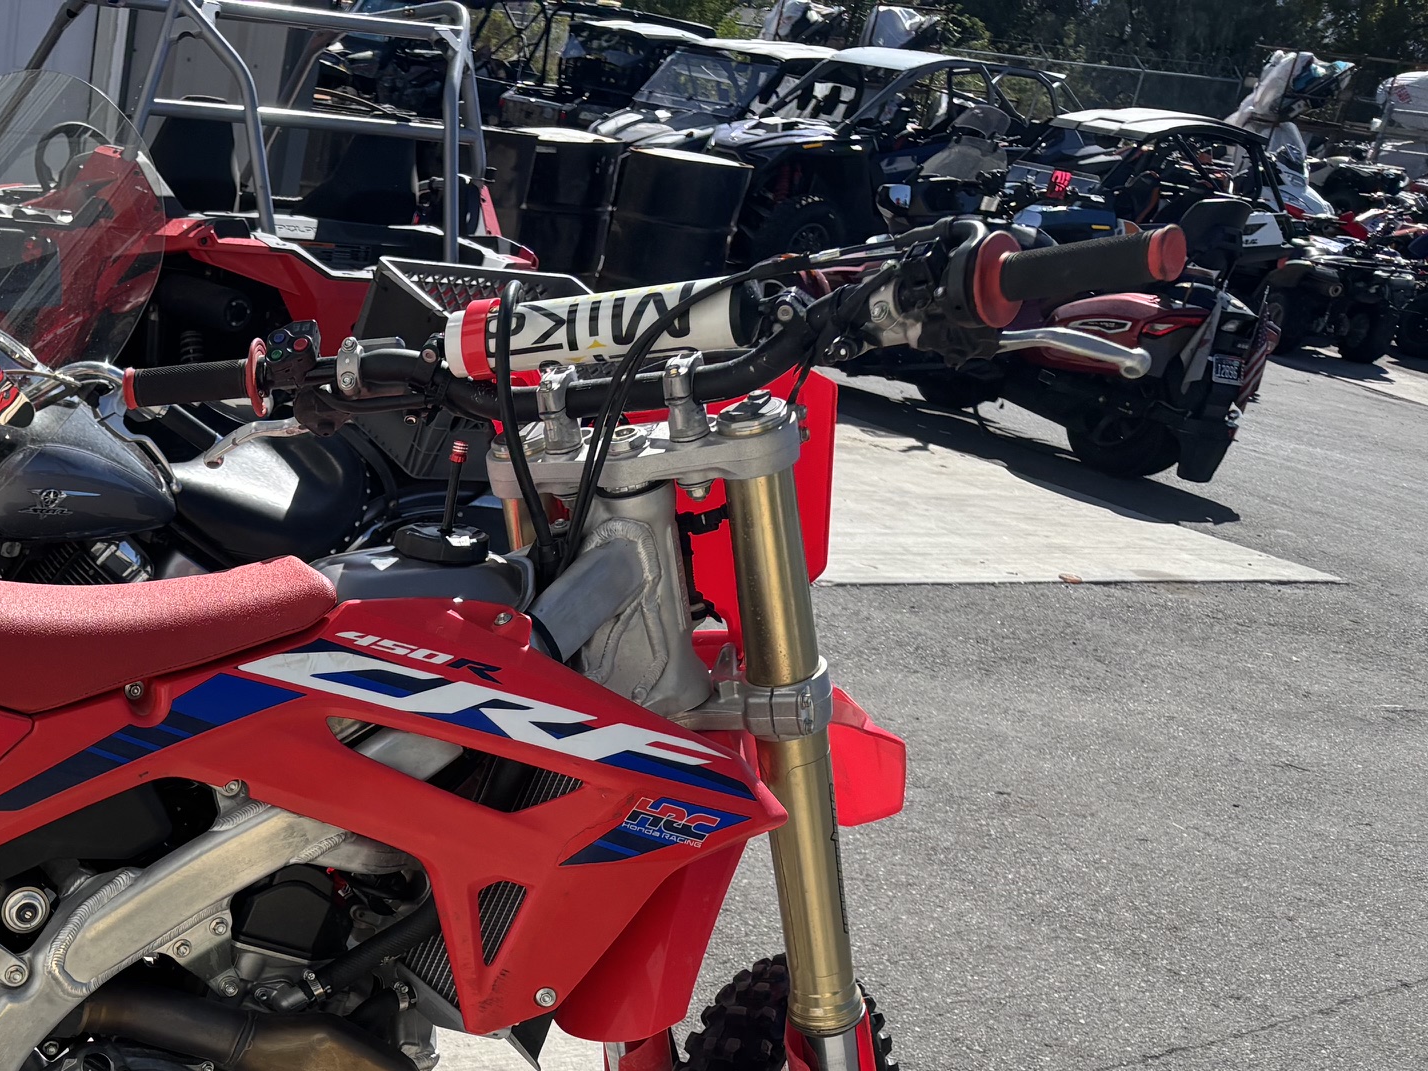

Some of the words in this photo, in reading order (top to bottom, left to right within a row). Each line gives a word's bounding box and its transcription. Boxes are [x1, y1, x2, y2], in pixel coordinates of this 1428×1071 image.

[334, 630, 503, 685] 450R
[237, 650, 732, 766] CRF
[622, 821, 661, 837] Honda
[661, 832, 703, 849] RACING
[623, 796, 721, 843] HRC
